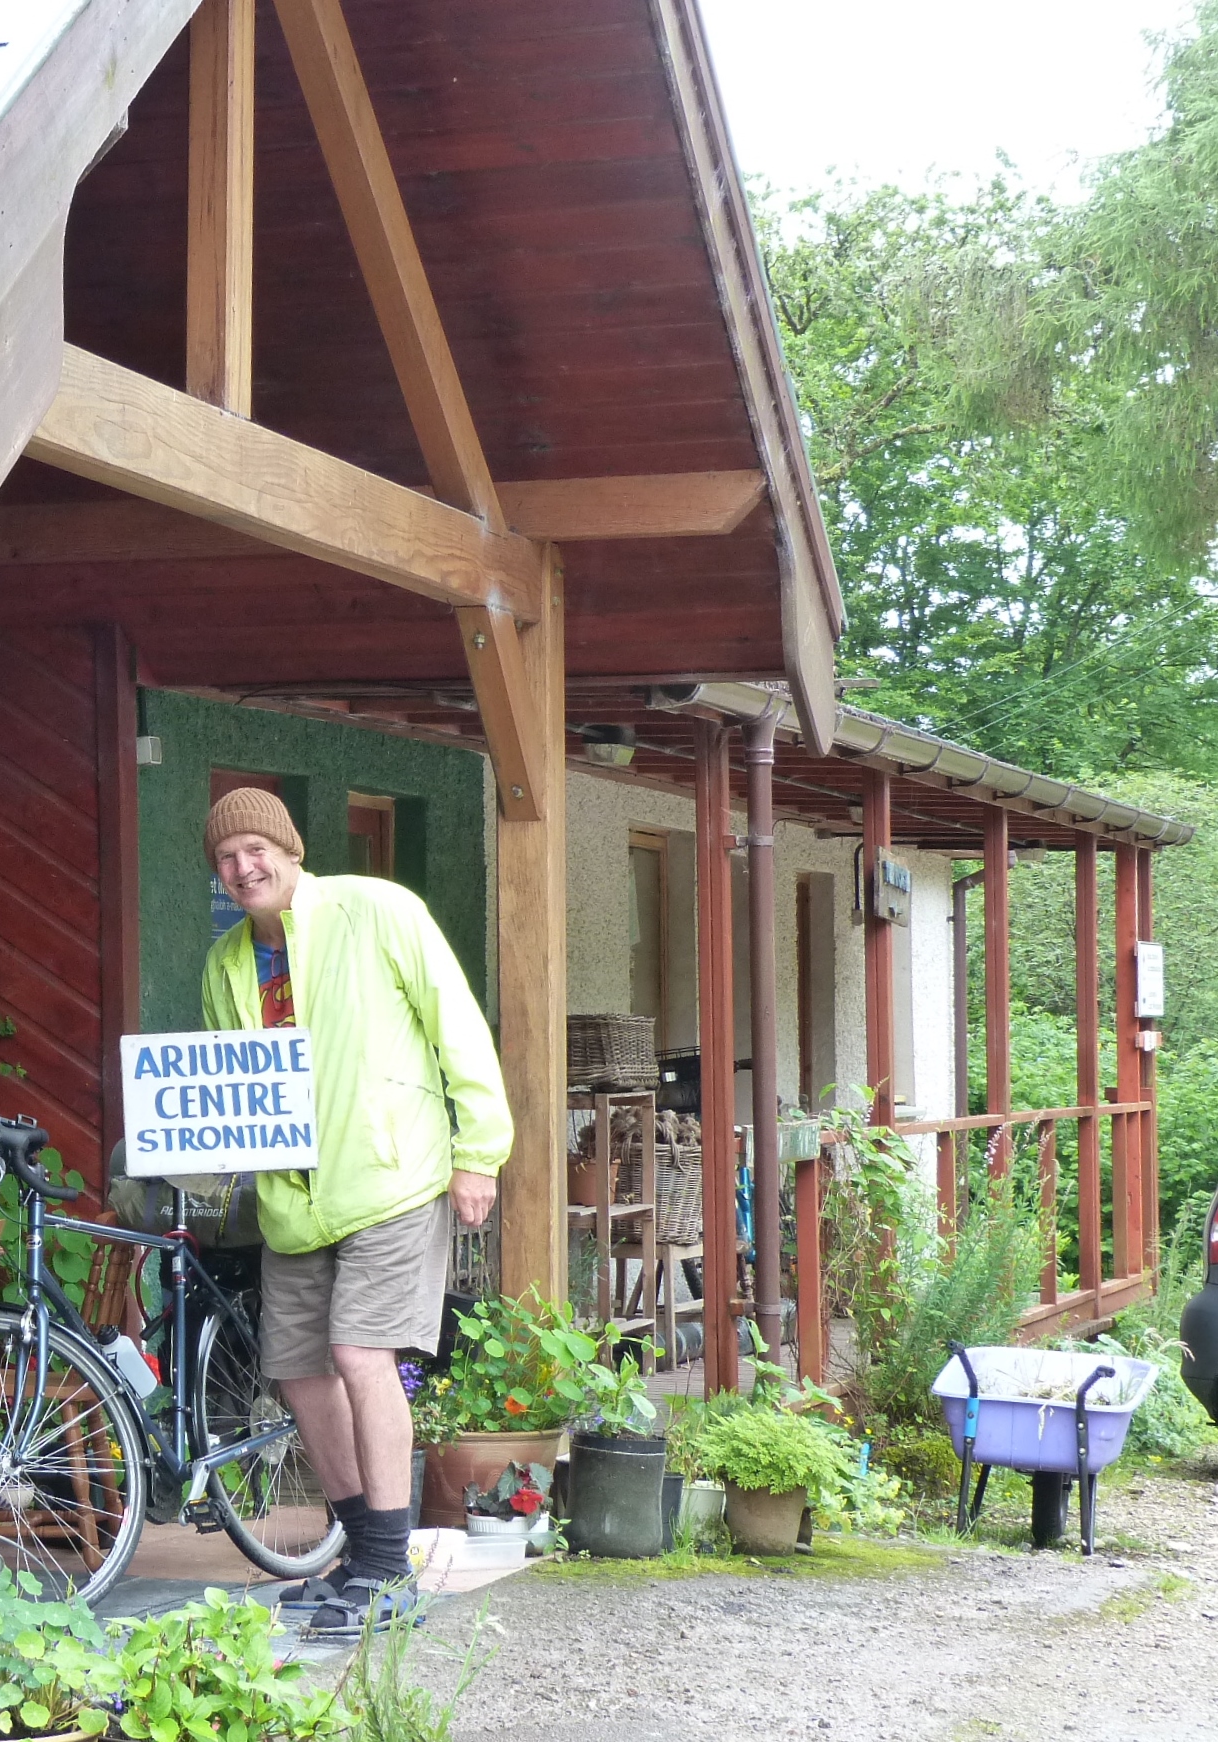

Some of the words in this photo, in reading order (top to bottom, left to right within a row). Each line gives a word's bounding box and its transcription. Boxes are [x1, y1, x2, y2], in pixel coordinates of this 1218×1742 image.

[134, 1038, 310, 1080] ARIUNDLE
[154, 1081, 293, 1120] CENTRE
[136, 1123, 312, 1153] STRONTIAN
